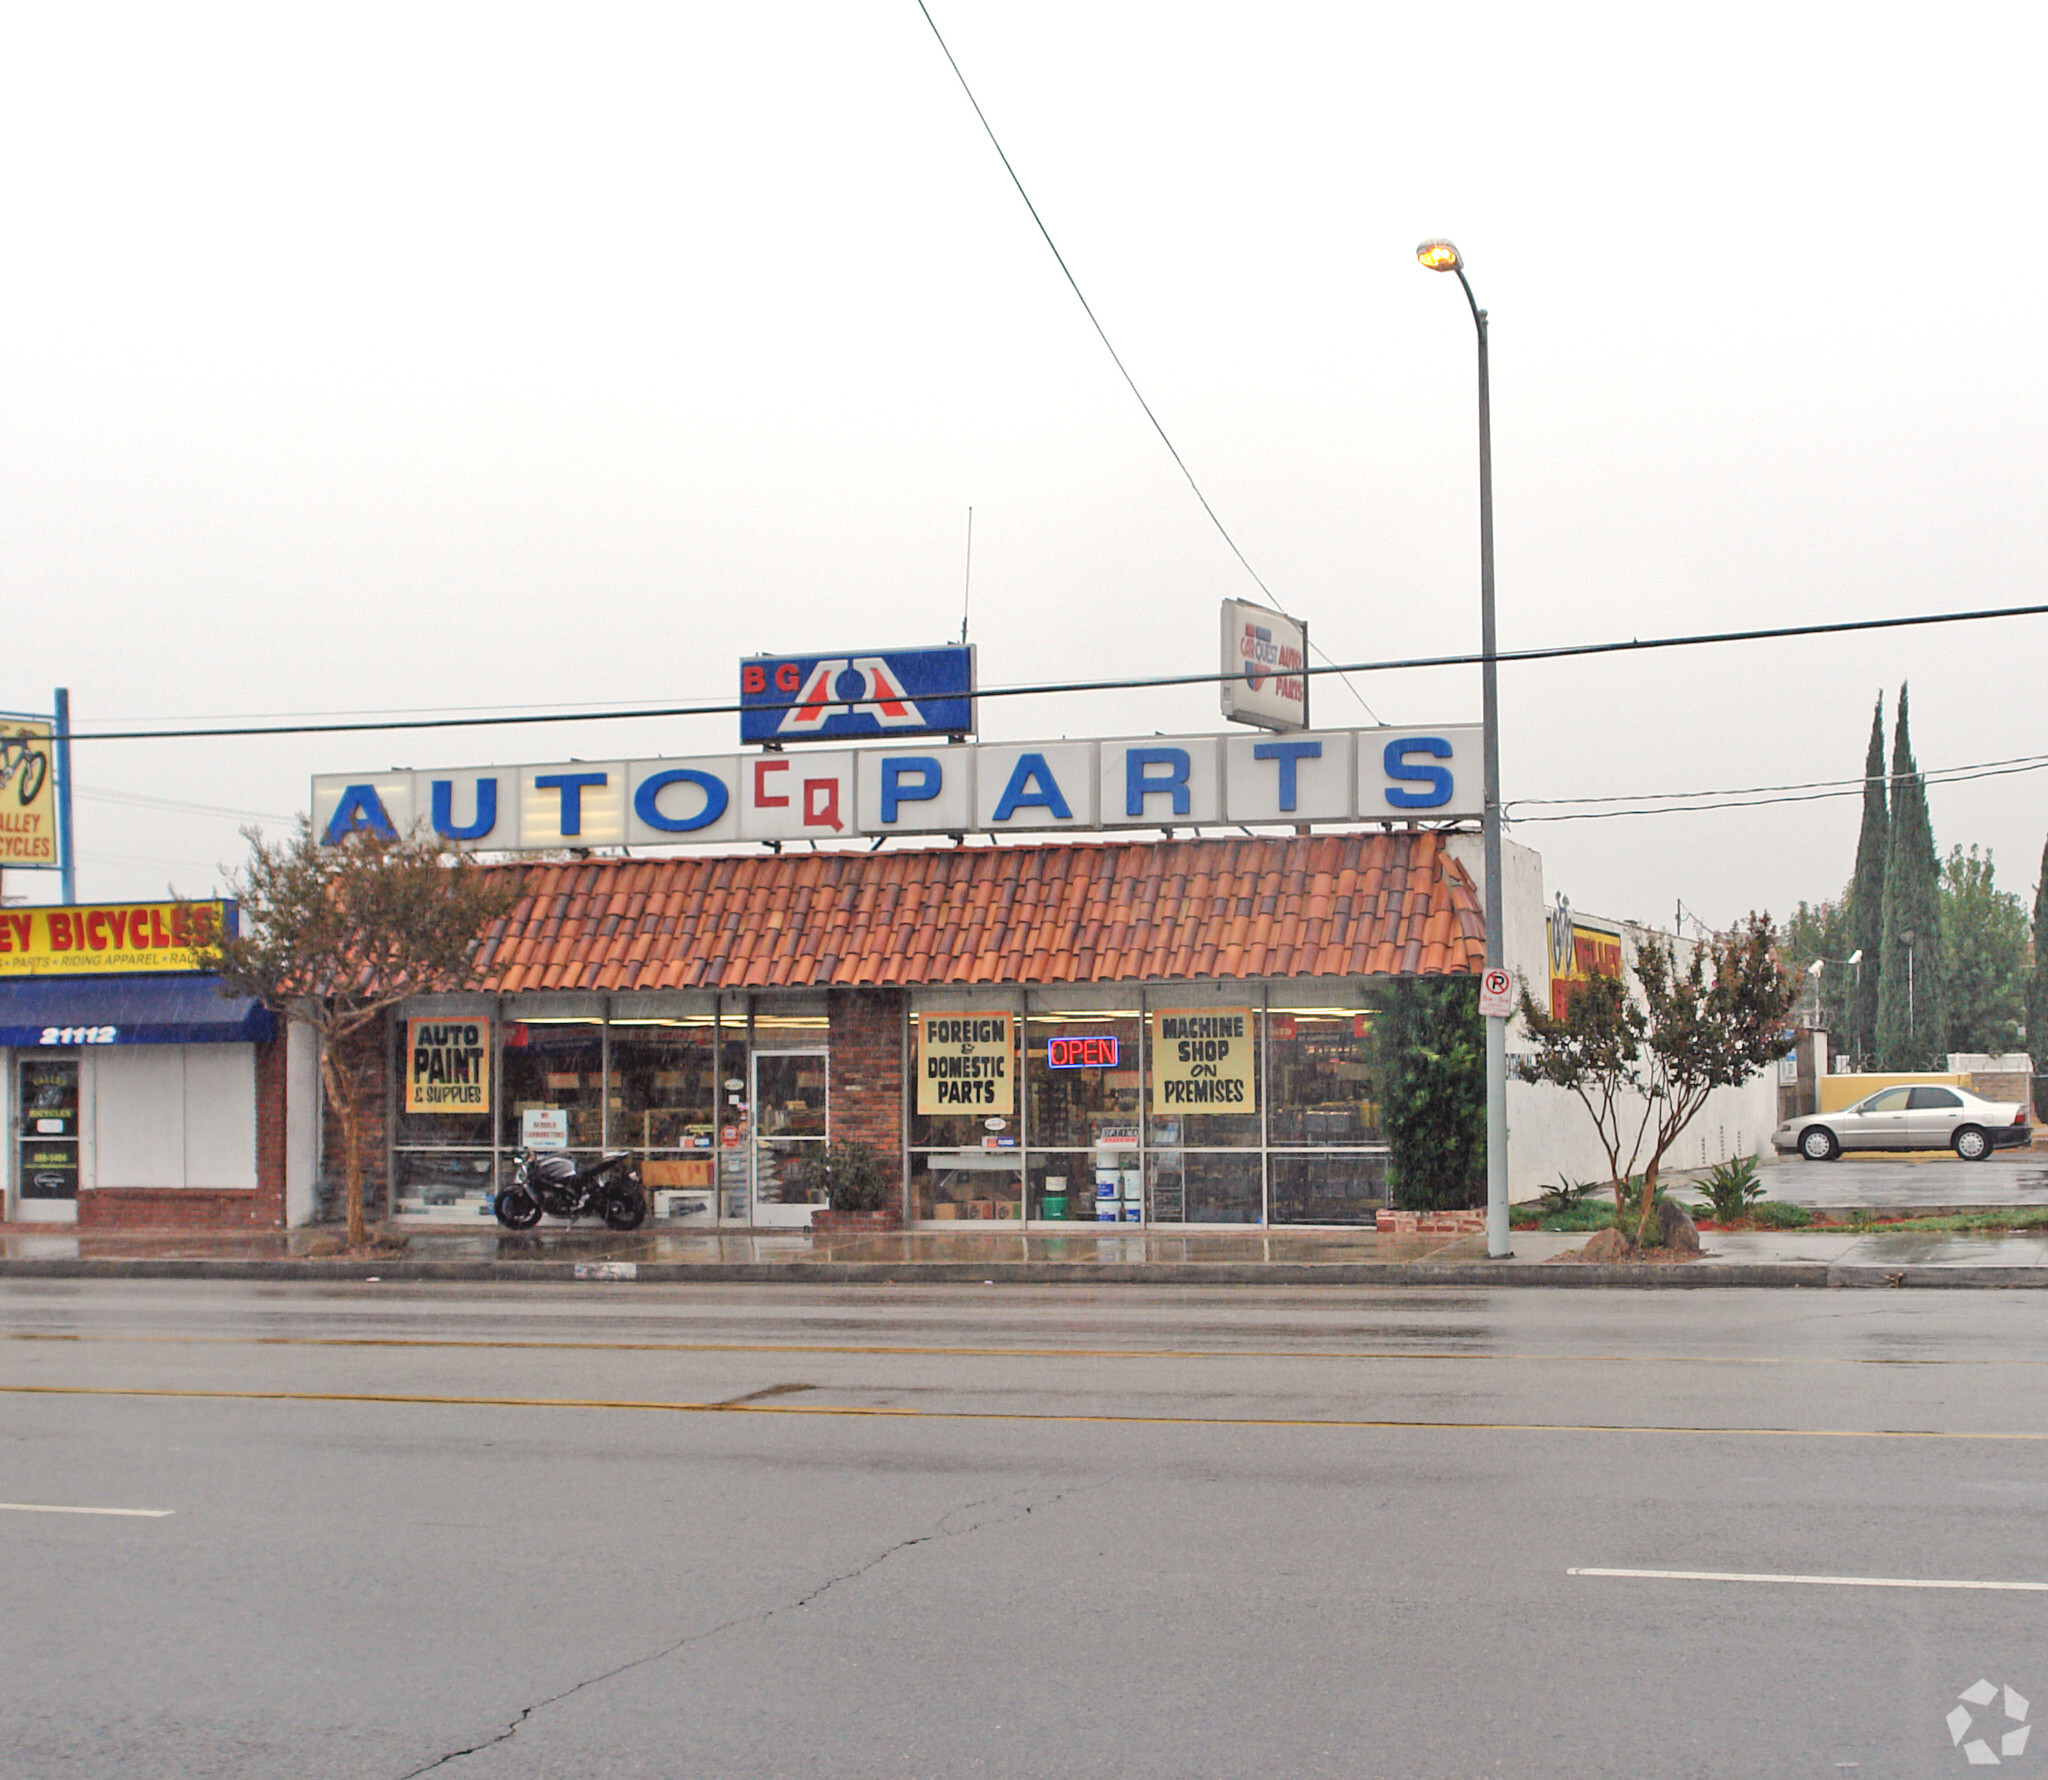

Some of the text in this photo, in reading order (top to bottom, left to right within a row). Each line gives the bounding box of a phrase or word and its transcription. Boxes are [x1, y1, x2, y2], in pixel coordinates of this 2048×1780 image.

[1279, 645, 1302, 672] AUTO
[1276, 675, 1304, 703] PARTS
[319, 769, 730, 848] AUTO
[880, 737, 1454, 824] PARTS
[12, 957, 50, 968] PARTS
[60, 955, 101, 967] RIDING
[103, 952, 158, 966] APPAREL
[39, 1025, 117, 1045] 21112
[417, 1025, 479, 1046] AUTO
[927, 1020, 1005, 1043] FOREIGN
[1162, 1017, 1243, 1039] MACHINE
[961, 1043, 975, 1055] &
[1050, 1039, 1116, 1065] OPEN
[1178, 1040, 1229, 1062] SHOP
[414, 1048, 484, 1084] PAINT
[927, 1056, 1005, 1078] DOMESTIC
[1190, 1064, 1217, 1078] ON
[426, 1086, 482, 1103] SUPPLIES
[938, 1080, 995, 1104] PARTS
[1164, 1079, 1244, 1104] PREMISES
